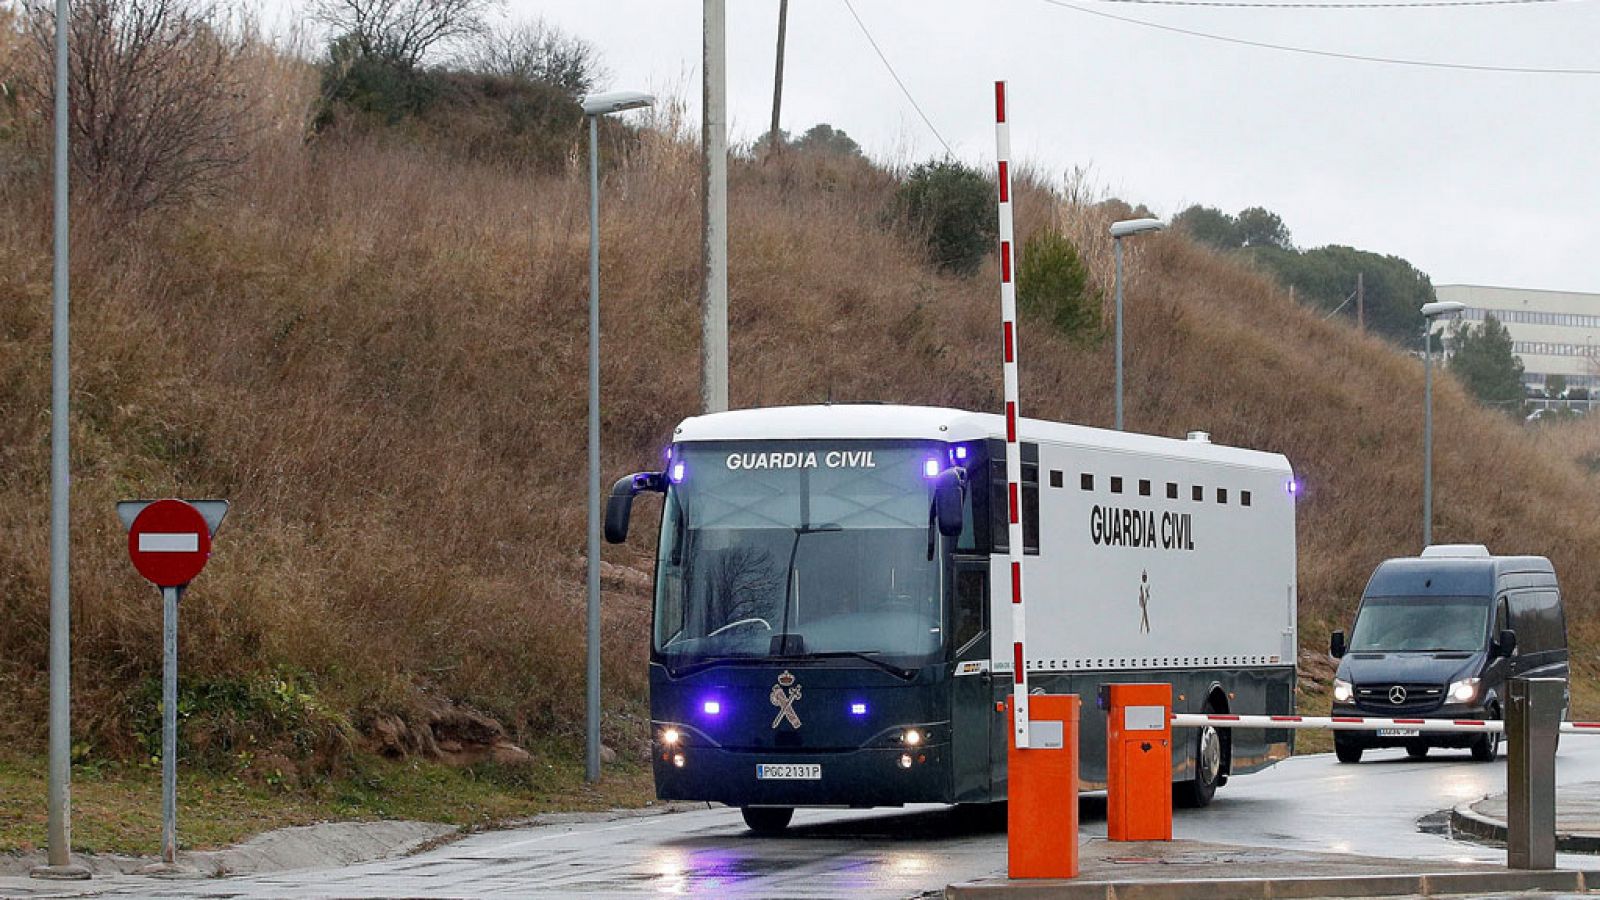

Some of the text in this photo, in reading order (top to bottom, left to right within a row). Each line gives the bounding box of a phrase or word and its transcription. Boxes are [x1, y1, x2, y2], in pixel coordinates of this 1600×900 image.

[726, 450, 876, 470] GUARDIA CIVIL
[1090, 504, 1195, 551] GUARDIA CIVIL
